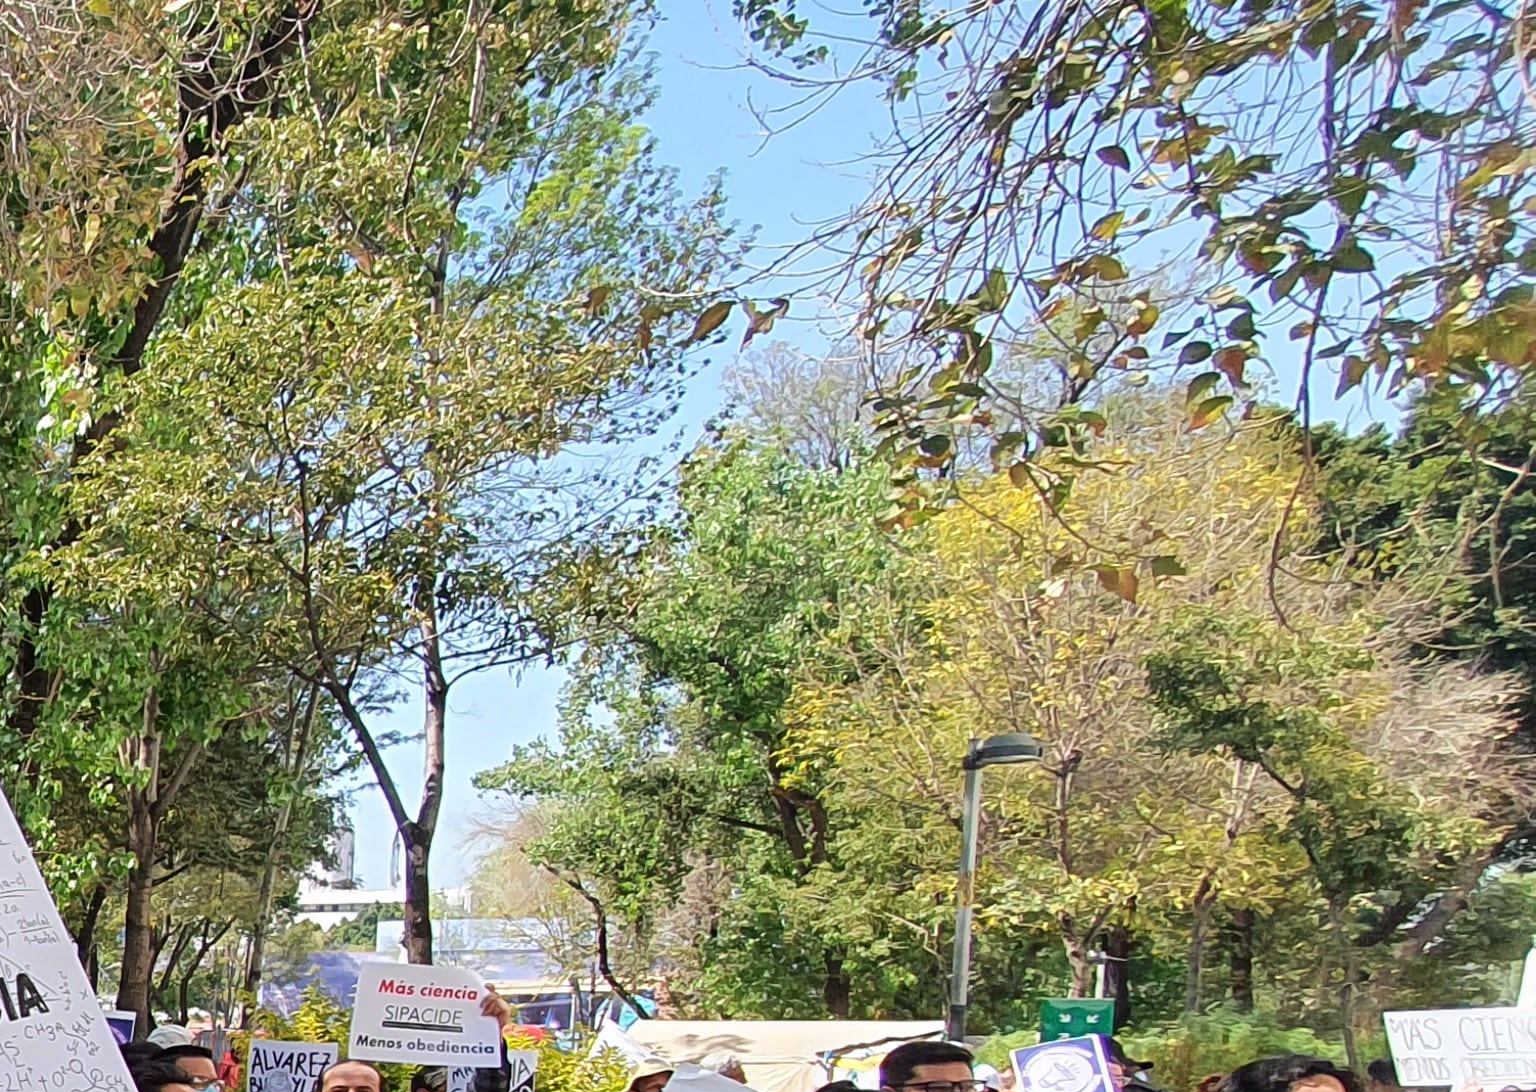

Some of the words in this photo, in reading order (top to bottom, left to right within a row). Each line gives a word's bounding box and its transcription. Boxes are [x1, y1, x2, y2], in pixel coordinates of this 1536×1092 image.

[377, 978, 416, 996] Más
[419, 981, 478, 1001] ciencia
[384, 1004, 464, 1026] SIPACIDE
[355, 1034, 403, 1049] Menos
[406, 1037, 495, 1055] obediencia
